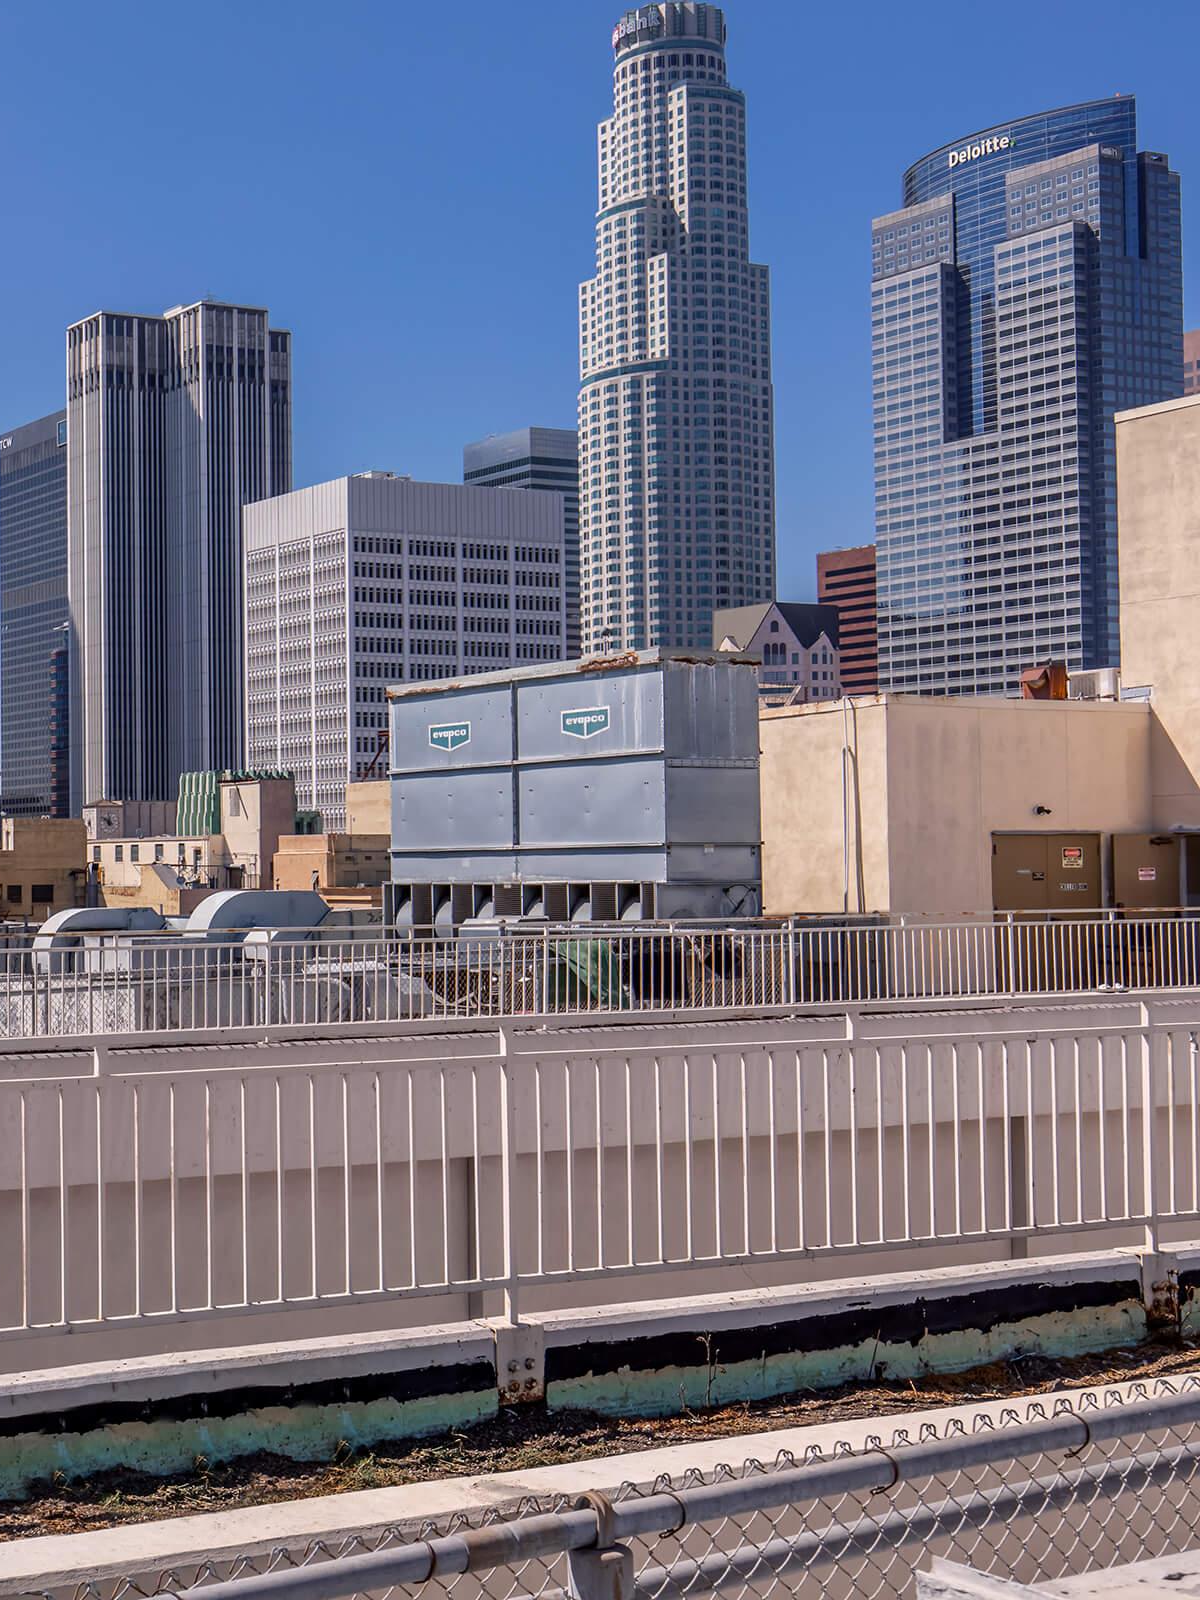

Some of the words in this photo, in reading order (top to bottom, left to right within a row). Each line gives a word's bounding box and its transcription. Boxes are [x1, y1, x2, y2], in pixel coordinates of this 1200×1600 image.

[0, 437, 13, 450] TCW
[565, 714, 605, 725] evapco
[432, 729, 467, 739] evapco
